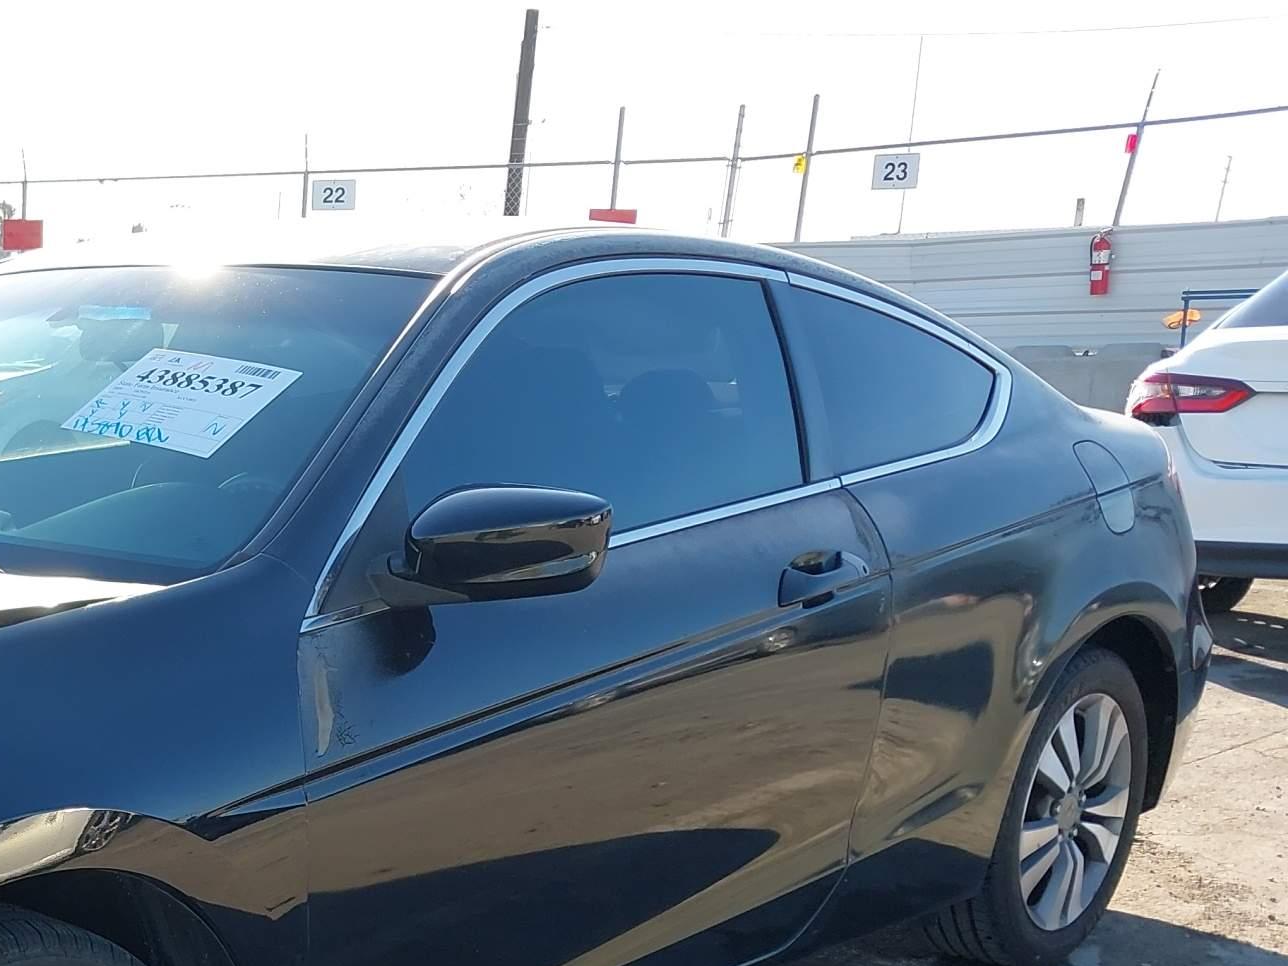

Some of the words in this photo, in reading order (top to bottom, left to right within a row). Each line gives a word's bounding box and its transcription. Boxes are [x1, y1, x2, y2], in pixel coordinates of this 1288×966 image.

[883, 162, 908, 181] 23
[322, 187, 345, 204] 22
[136, 367, 263, 399] 43885387
